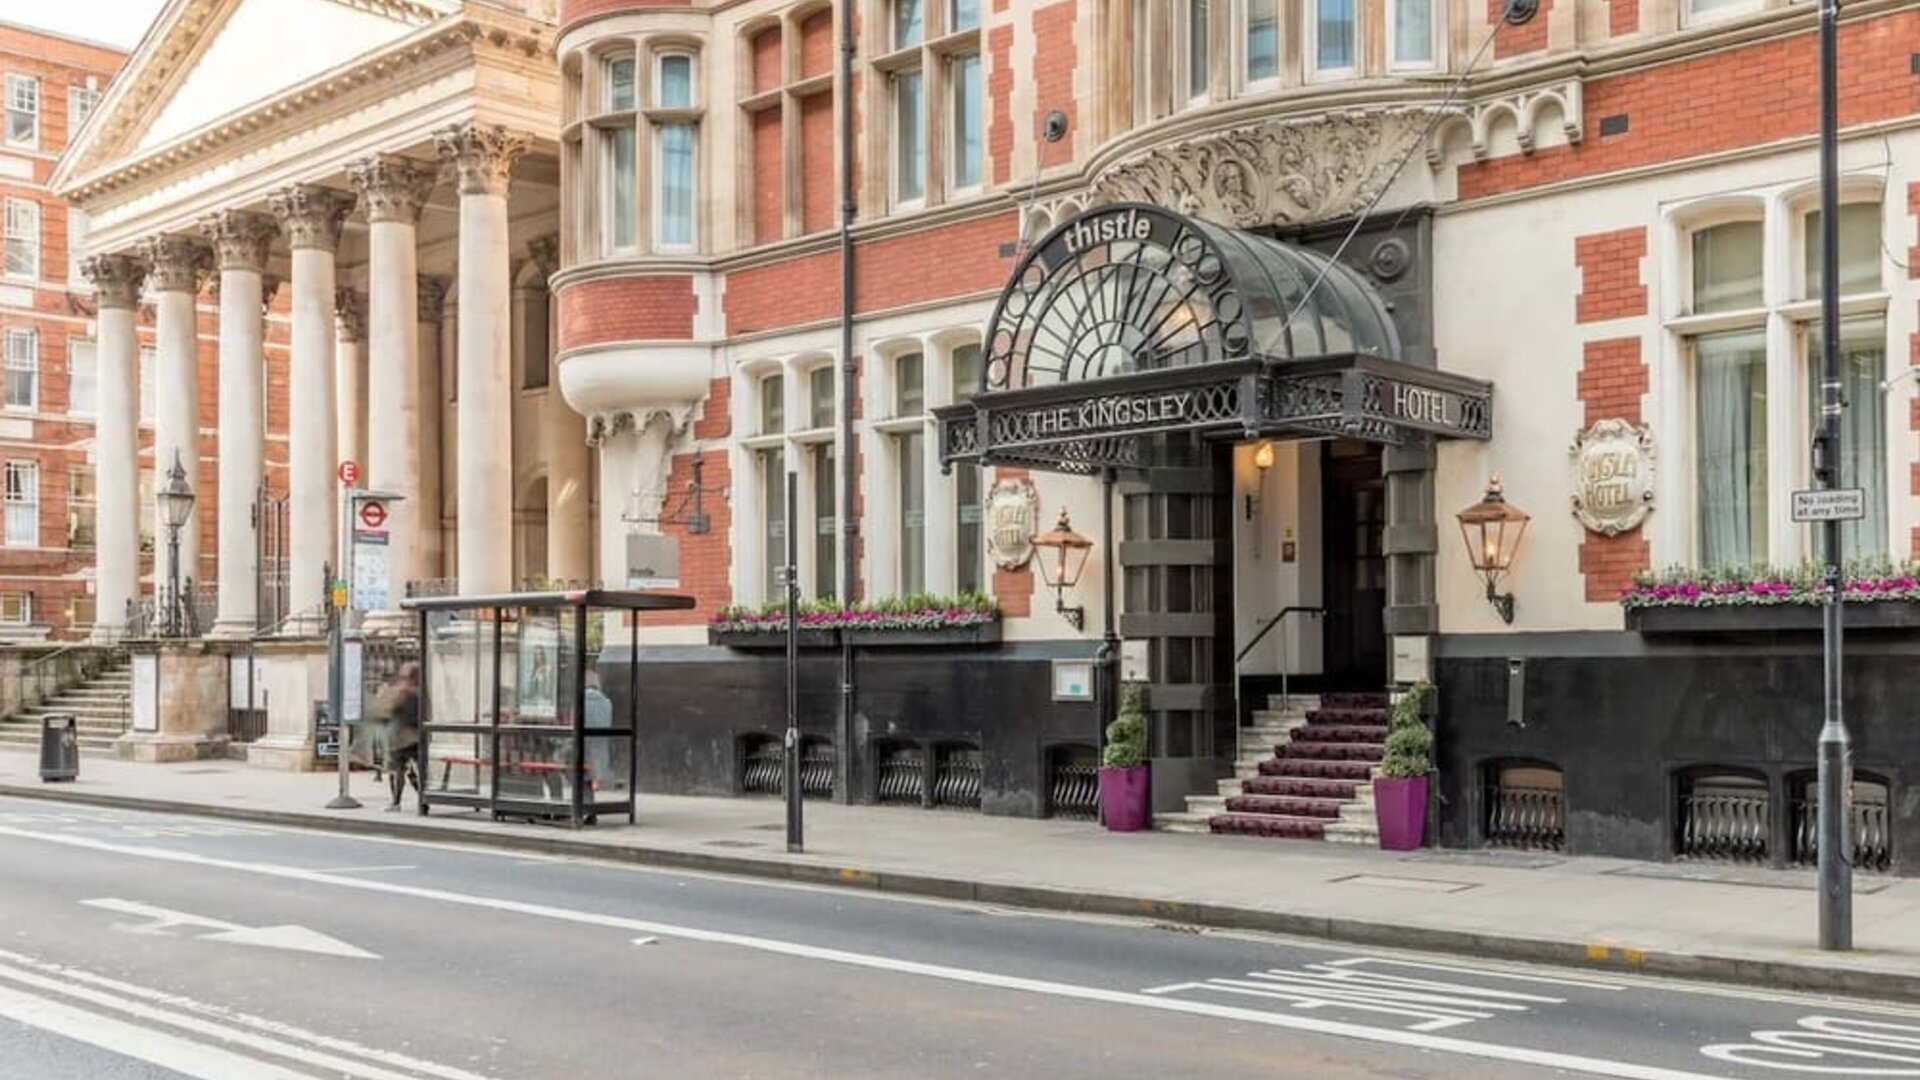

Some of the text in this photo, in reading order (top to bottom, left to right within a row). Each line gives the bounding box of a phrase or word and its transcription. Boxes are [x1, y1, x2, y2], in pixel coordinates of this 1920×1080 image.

[1064, 208, 1151, 253] thistle
[1029, 393, 1190, 437] THE KINGSLEY
[1393, 384, 1453, 425] HOTEL
[343, 464, 354, 480] E
[1585, 482, 1634, 506] HOTEL
[1798, 496, 1814, 505] No
[1797, 507, 1808, 516] at
[1812, 508, 1831, 517] any
